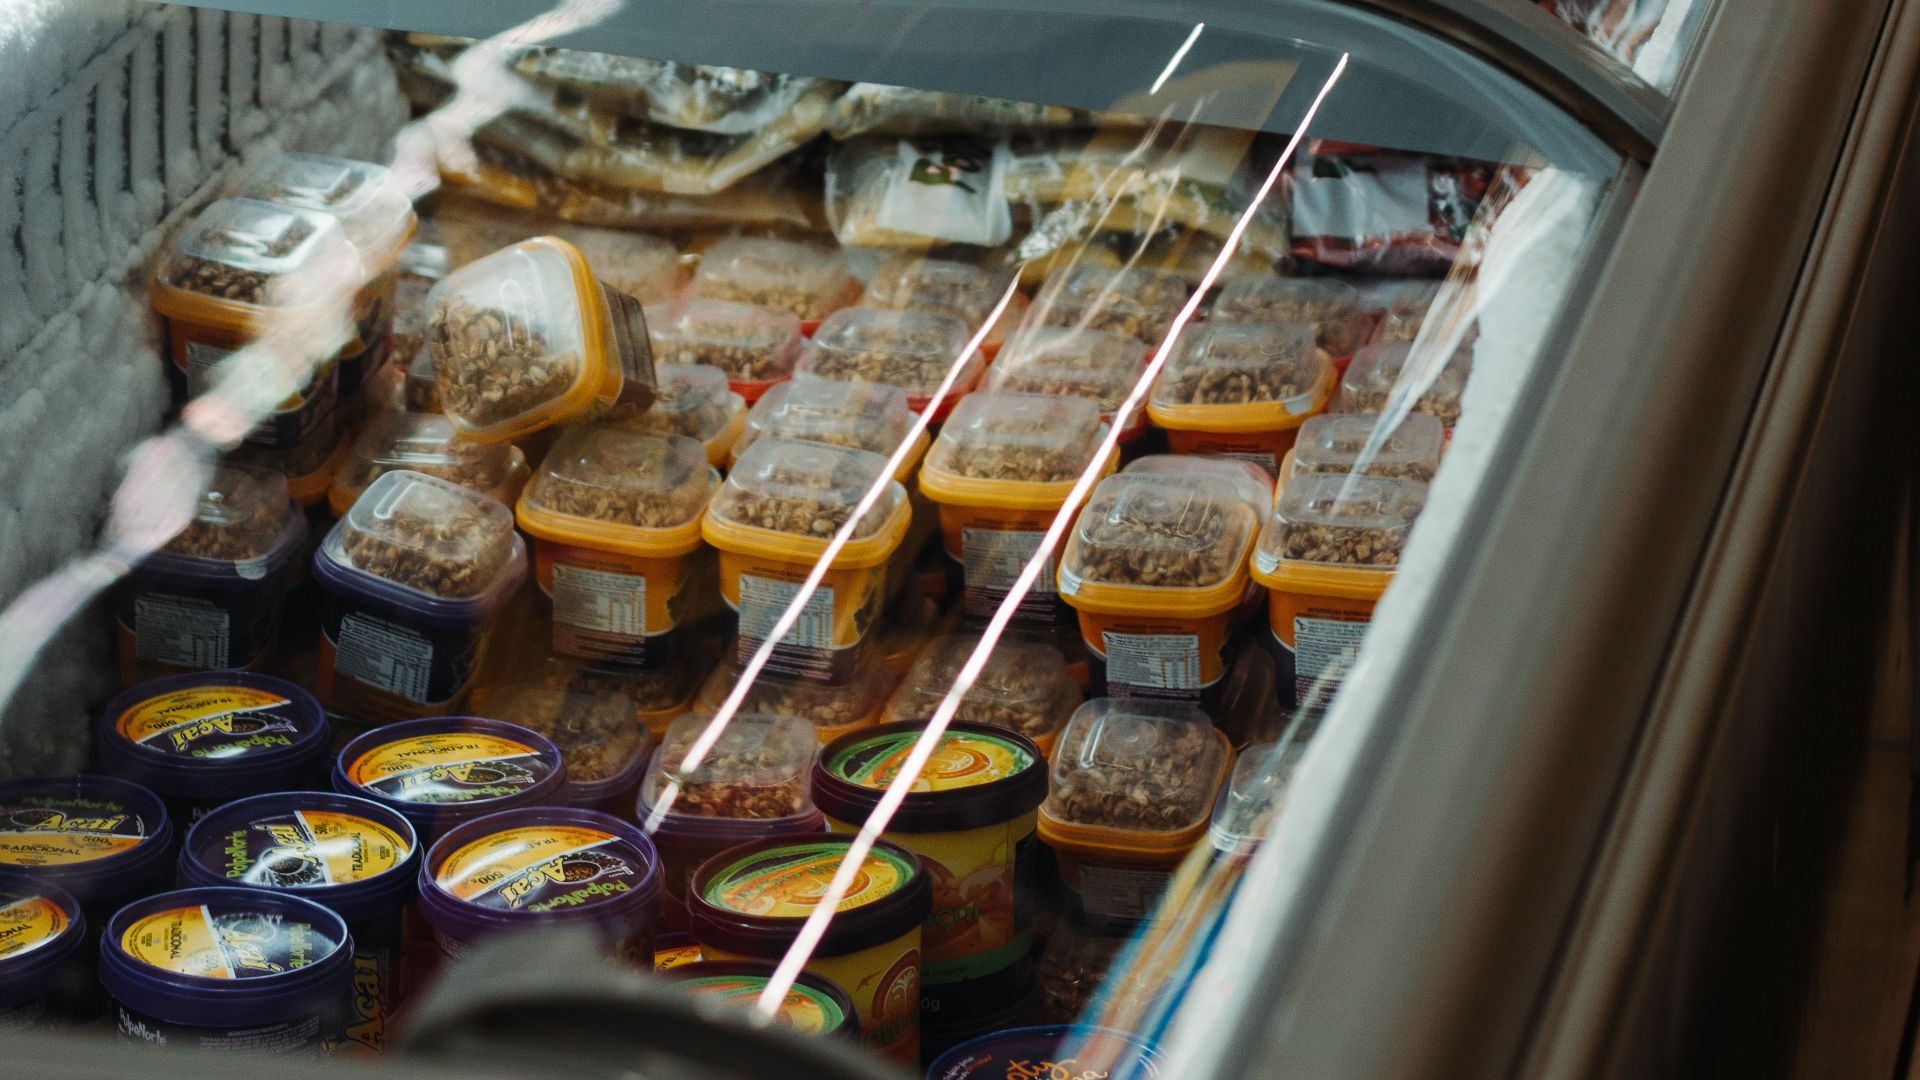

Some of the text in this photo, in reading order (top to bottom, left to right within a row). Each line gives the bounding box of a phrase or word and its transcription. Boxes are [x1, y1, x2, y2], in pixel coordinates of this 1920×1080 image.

[169, 713, 234, 752] Açaí
[394, 743, 480, 758] TRADICIONAL
[27, 814, 129, 832] Açaí
[470, 869, 504, 885] 500g
[499, 857, 565, 909] Açaí
[528, 879, 632, 912] PolpaNorte
[119, 1007, 168, 1046] PolpaNorte
